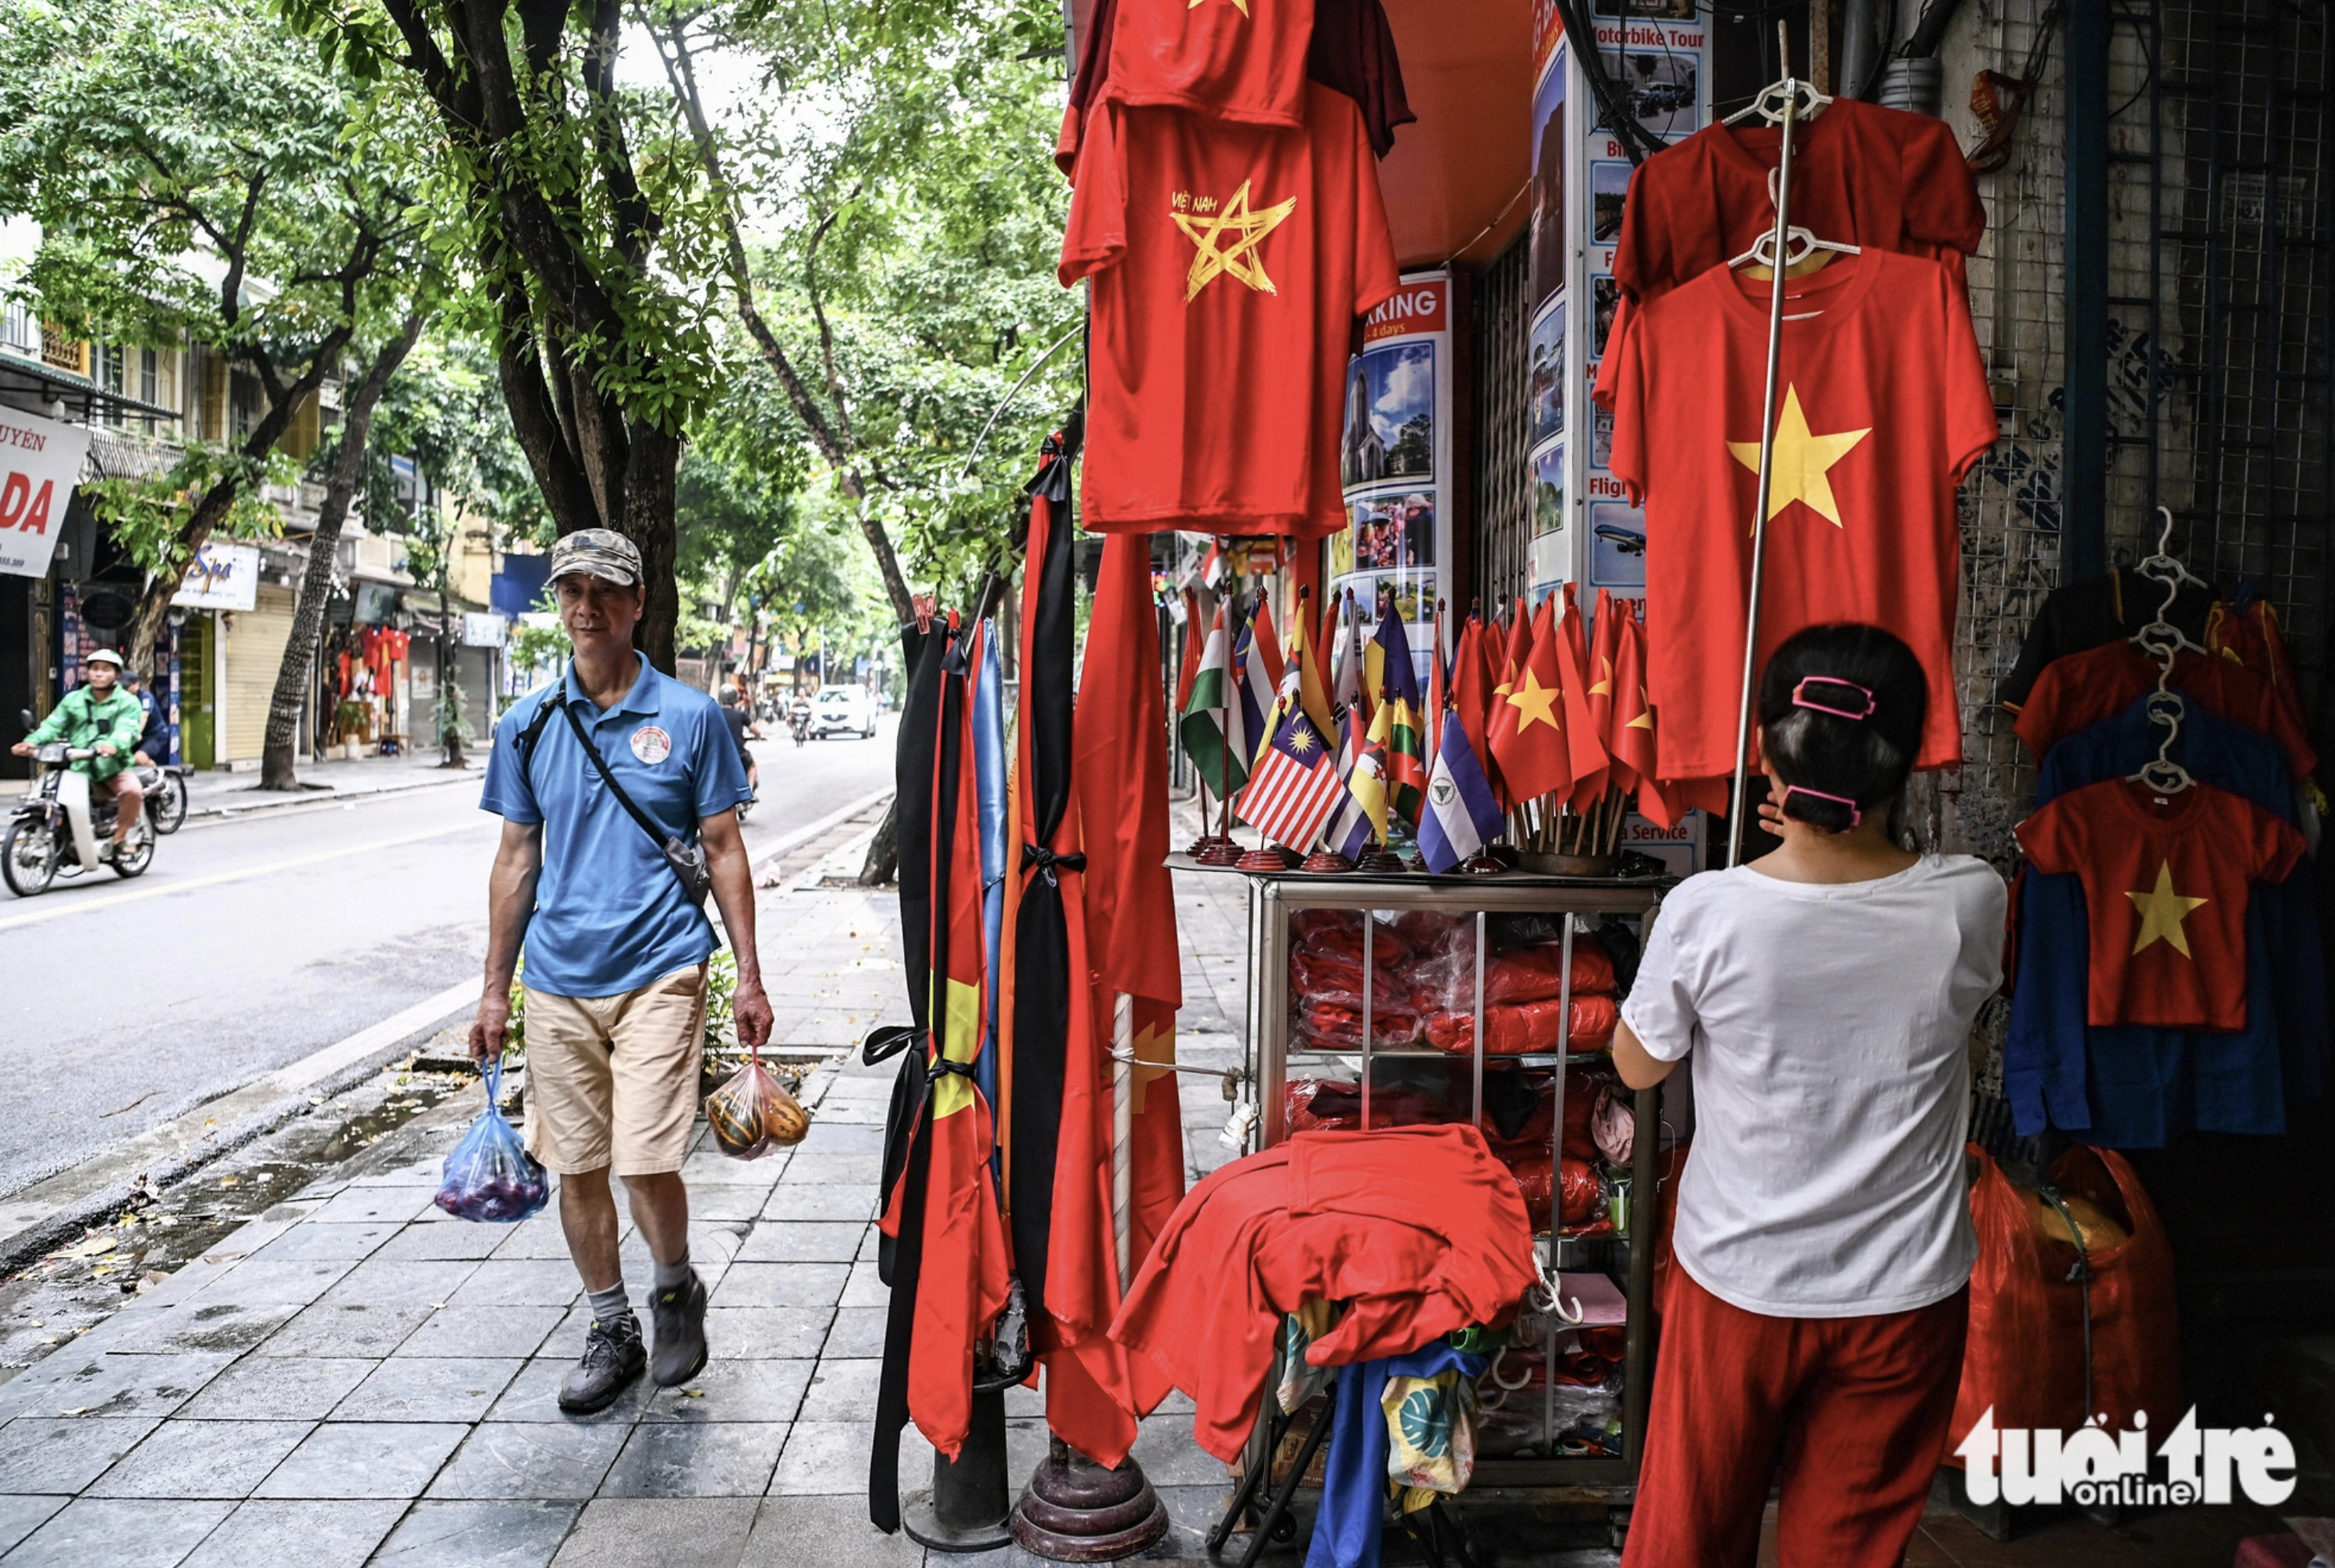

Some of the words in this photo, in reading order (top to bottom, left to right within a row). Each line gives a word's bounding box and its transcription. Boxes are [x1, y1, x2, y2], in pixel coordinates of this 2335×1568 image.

[1669, 30, 1705, 47] Tour
[1192, 195, 1218, 212] NAM
[1372, 327, 1377, 337] 4
[1380, 323, 1406, 336] days
[1589, 478, 1626, 497] Flig
[0, 471, 54, 535] DA
[188, 545, 232, 597] Spa
[1633, 824, 1687, 840] Service
